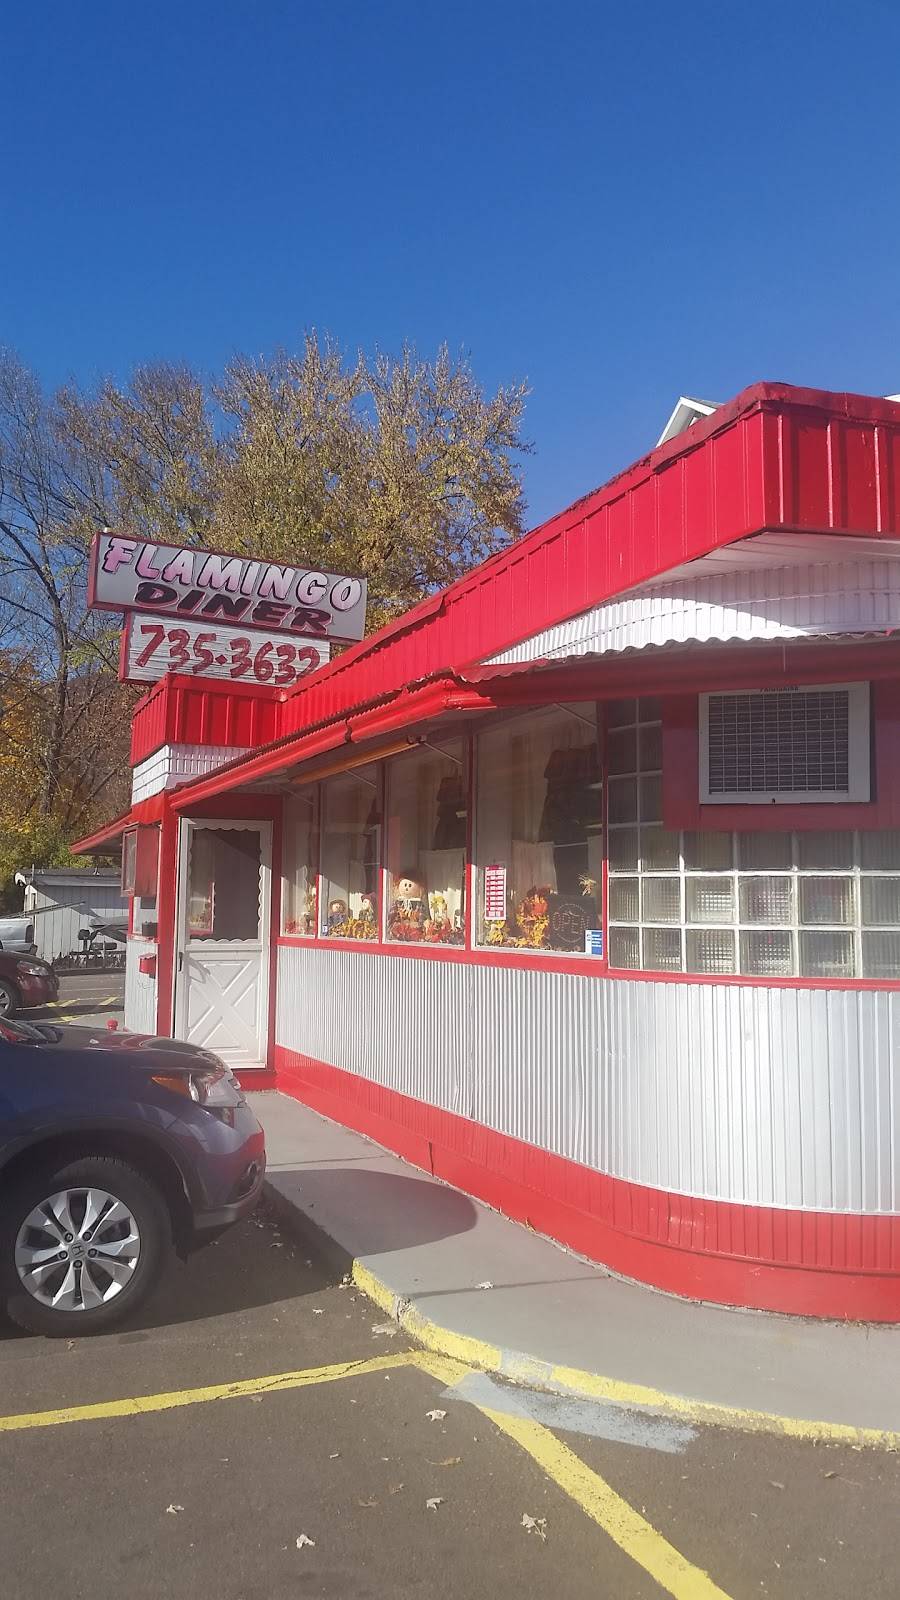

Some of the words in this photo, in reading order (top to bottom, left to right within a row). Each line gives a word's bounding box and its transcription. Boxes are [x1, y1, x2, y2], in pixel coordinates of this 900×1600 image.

[102, 537, 363, 611] FLAMINGO
[134, 581, 334, 636] DINER
[552, 911, 590, 935] OPEN
